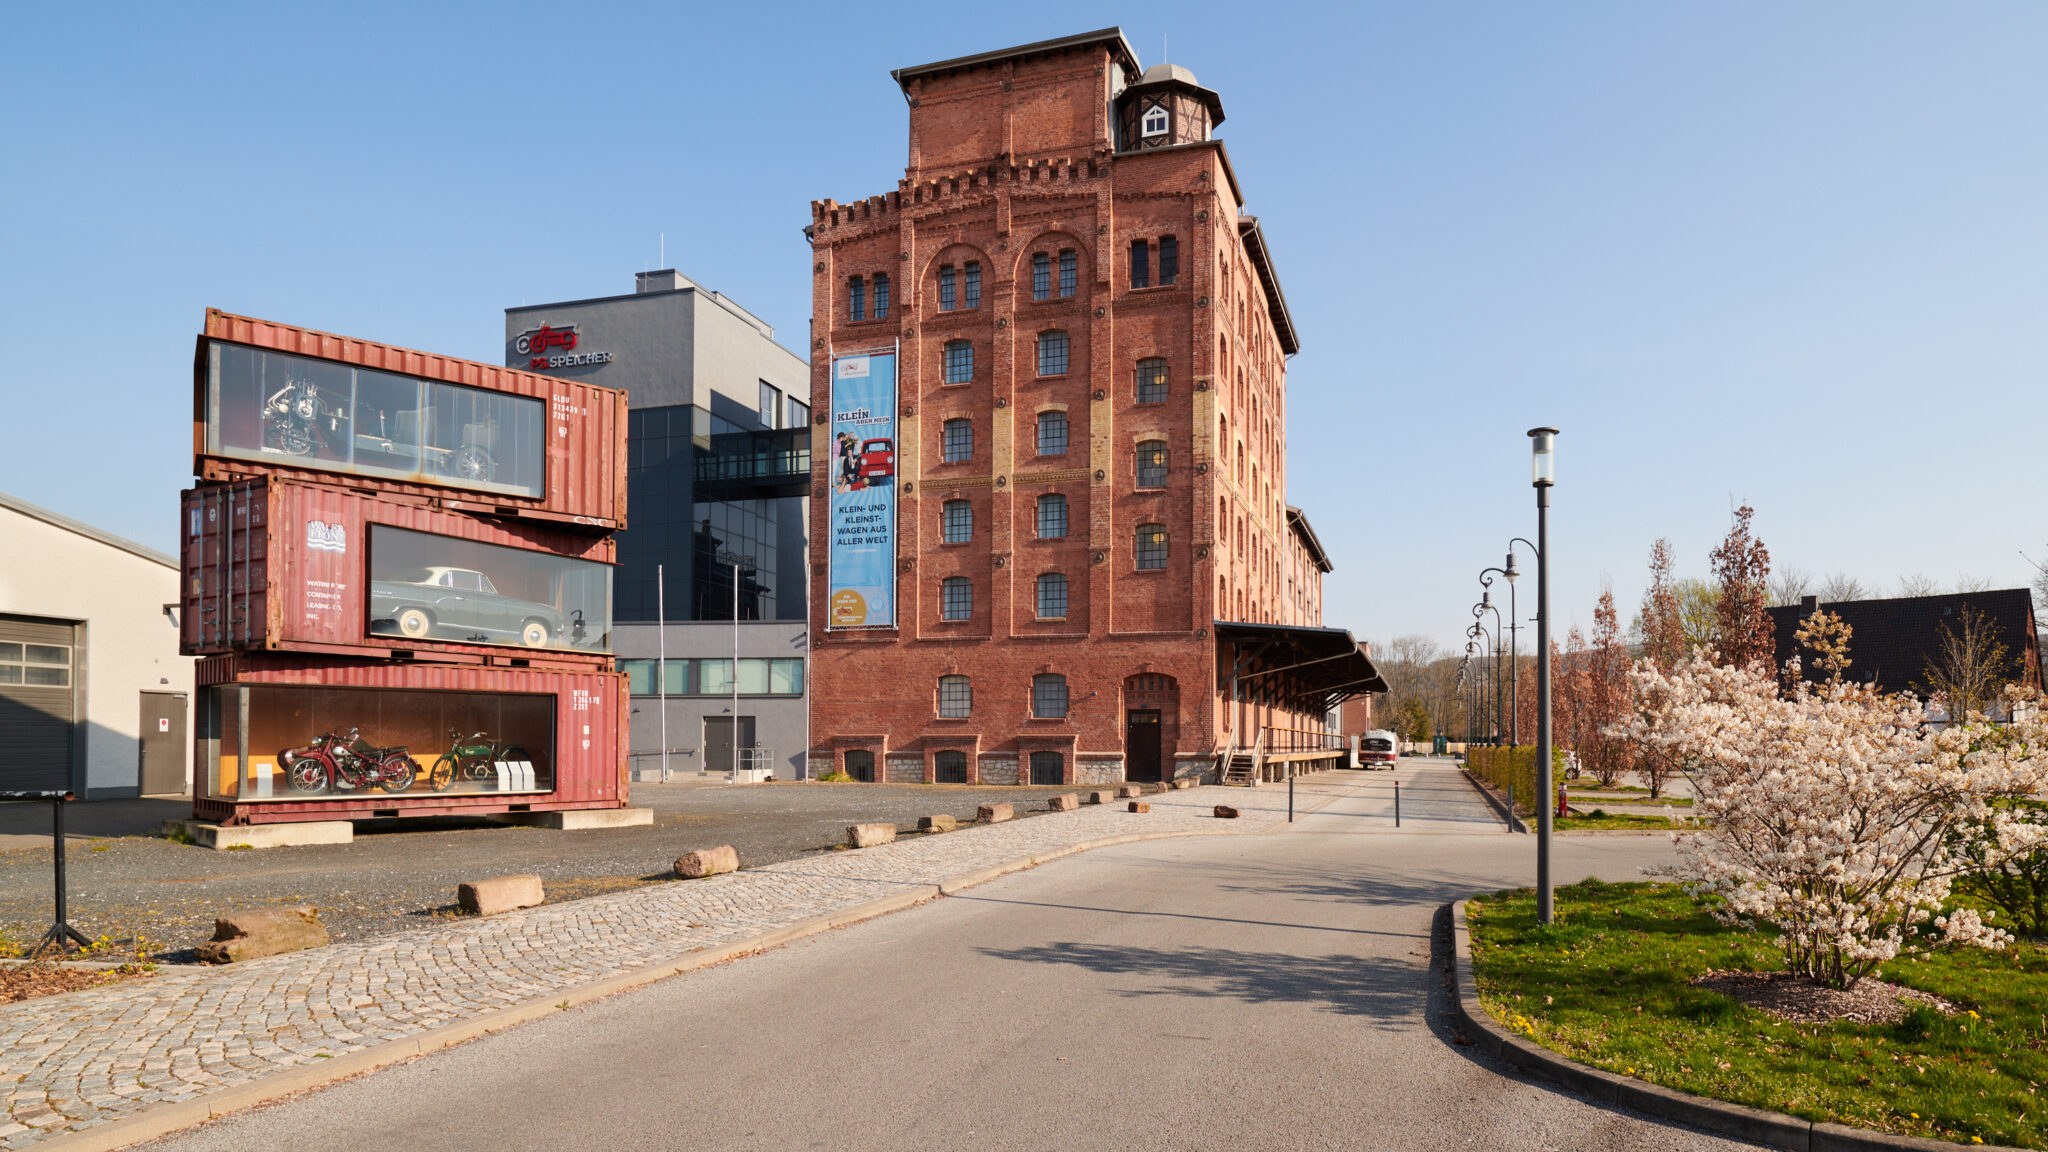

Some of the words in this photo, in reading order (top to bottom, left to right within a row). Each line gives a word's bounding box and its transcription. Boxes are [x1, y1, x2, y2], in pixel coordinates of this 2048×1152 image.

[530, 352, 613, 370] PS.SPEICHER
[837, 408, 869, 421] KLEIN
[839, 505, 866, 513] KLEIN-
[868, 504, 886, 512] UND
[845, 515, 882, 524] KLEINST-
[837, 526, 868, 535] WAGEN
[870, 525, 887, 533] AUS
[837, 537, 863, 545] ALLER
[865, 536, 888, 544] WELT
